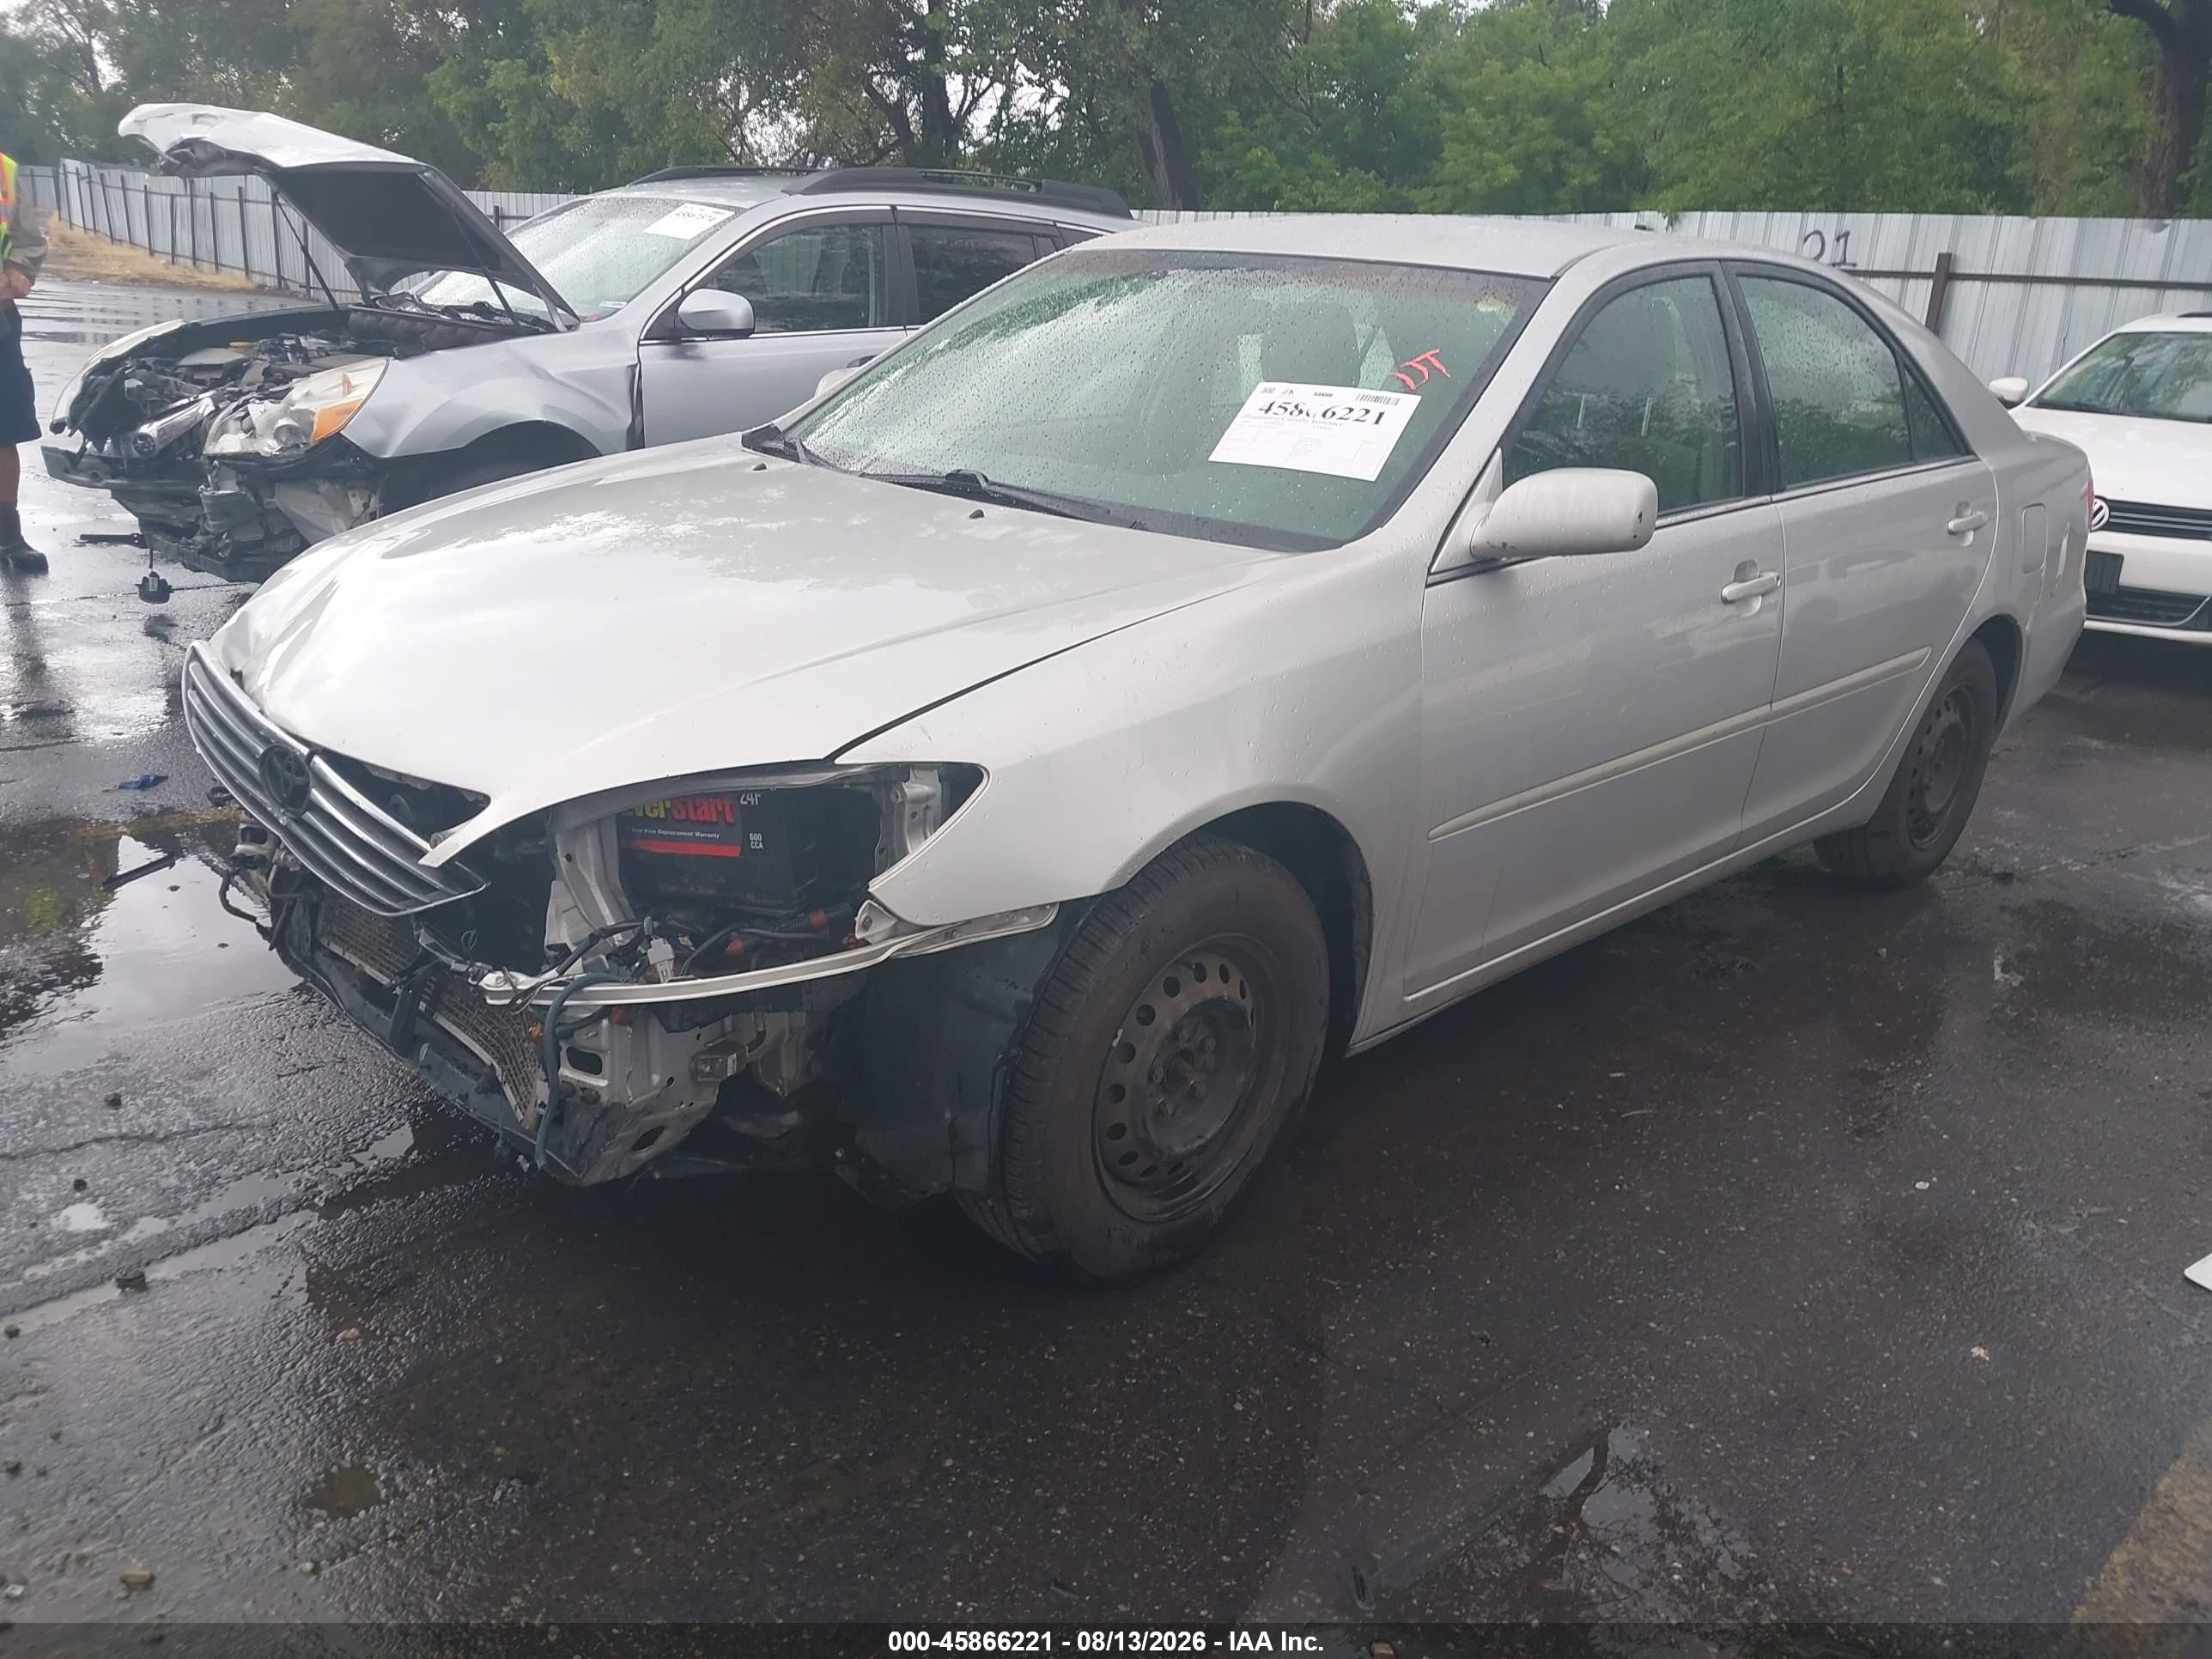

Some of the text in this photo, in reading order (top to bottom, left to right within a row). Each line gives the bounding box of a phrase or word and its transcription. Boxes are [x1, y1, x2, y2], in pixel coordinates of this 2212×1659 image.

[1804, 229, 1857, 268] 21
[695, 830, 720, 839] Warranty
[750, 841, 763, 849] CCA
